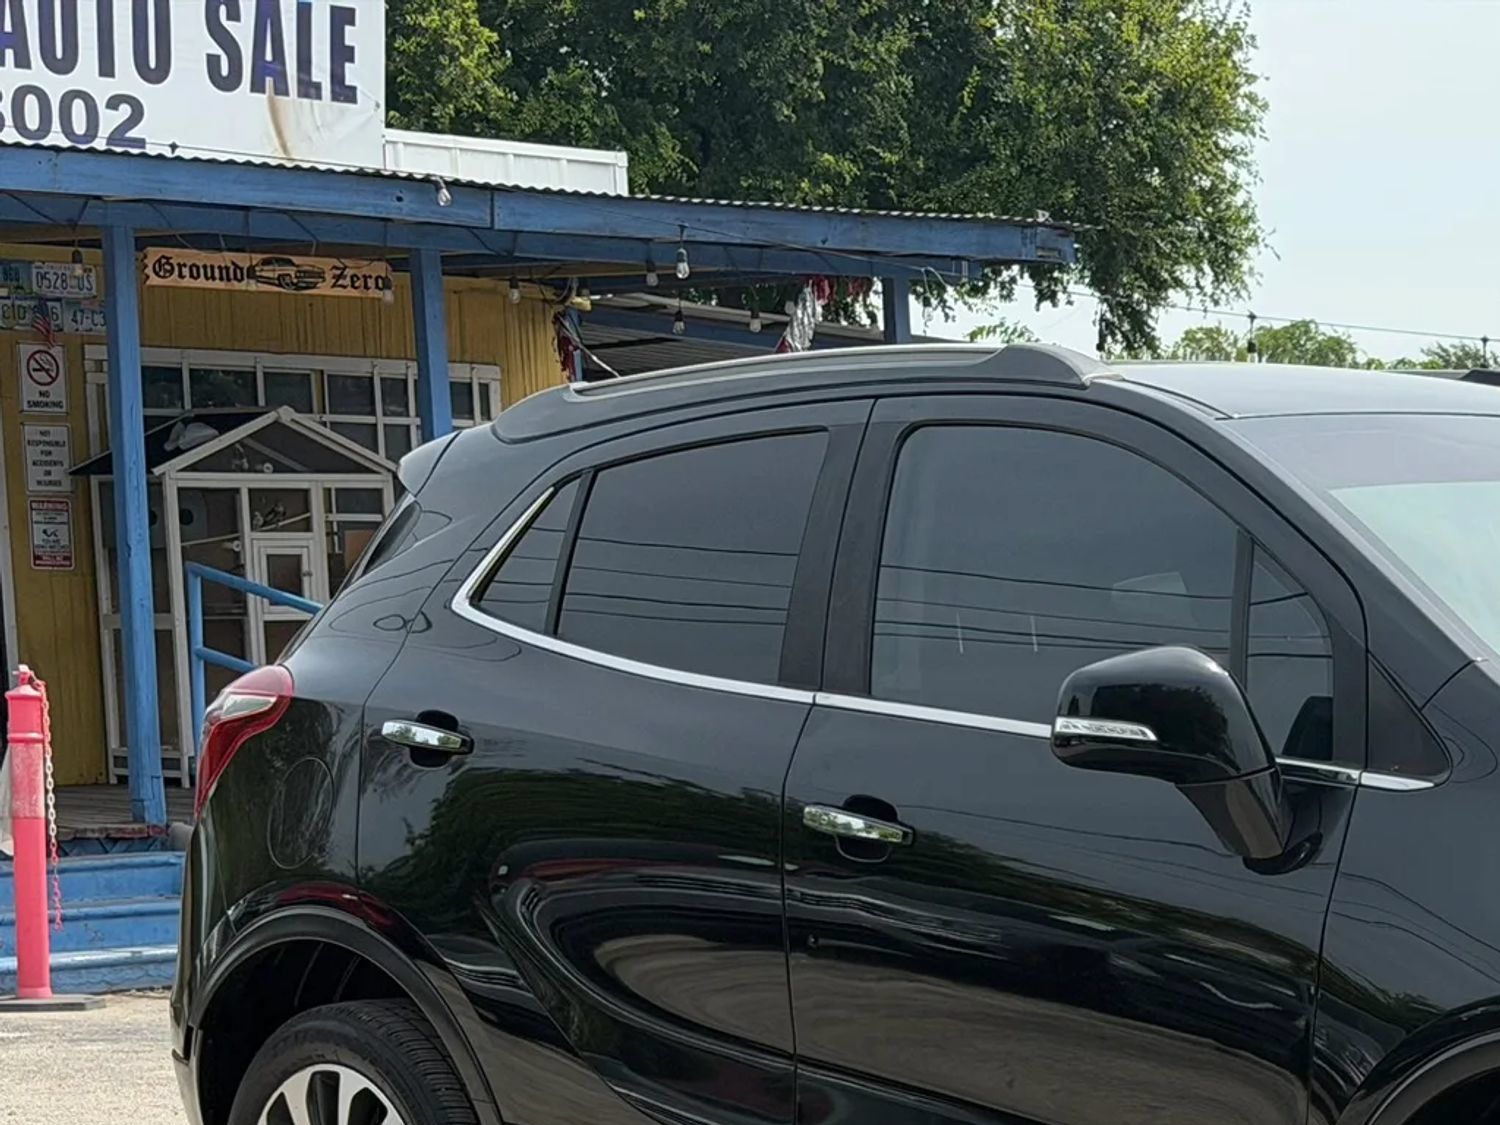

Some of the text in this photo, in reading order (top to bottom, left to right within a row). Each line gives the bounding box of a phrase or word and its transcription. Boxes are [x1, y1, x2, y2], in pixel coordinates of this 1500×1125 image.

[205, 0, 358, 105] SALE
[0, 83, 147, 149] 002
[152, 254, 387, 291] Ground Zero
[27, 400, 64, 409] SMOKING
[39, 390, 51, 399] NO
